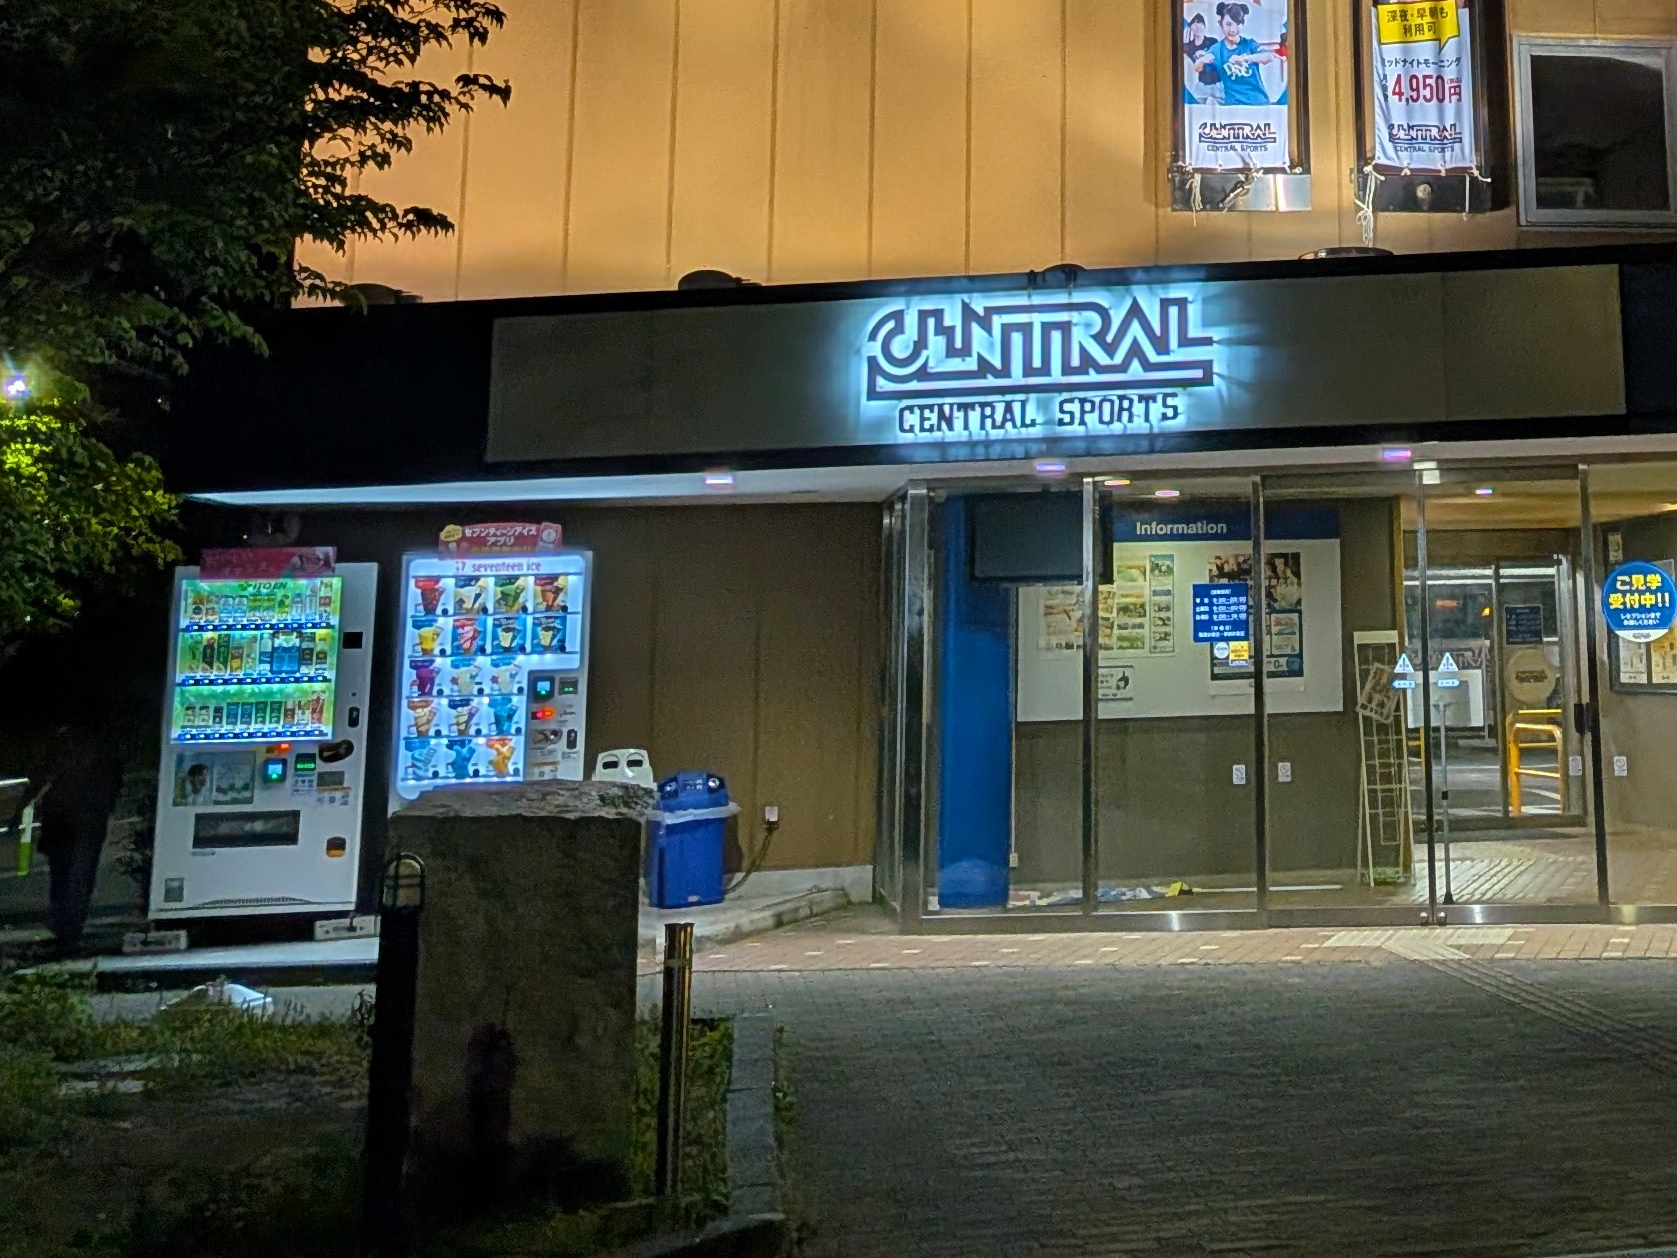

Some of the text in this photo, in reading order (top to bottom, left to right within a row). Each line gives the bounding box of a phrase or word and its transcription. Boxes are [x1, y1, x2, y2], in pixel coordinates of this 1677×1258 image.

[1402, 21, 1437, 38] 利用可
[1198, 121, 1277, 144] CENTRAL
[866, 295, 1214, 401] CENTRAL
[898, 392, 1180, 434] CENTRAL SPORTS
[1136, 520, 1228, 535] Information
[1616, 573, 1663, 590] ご見学
[1609, 592, 1670, 610] 受付中!!
